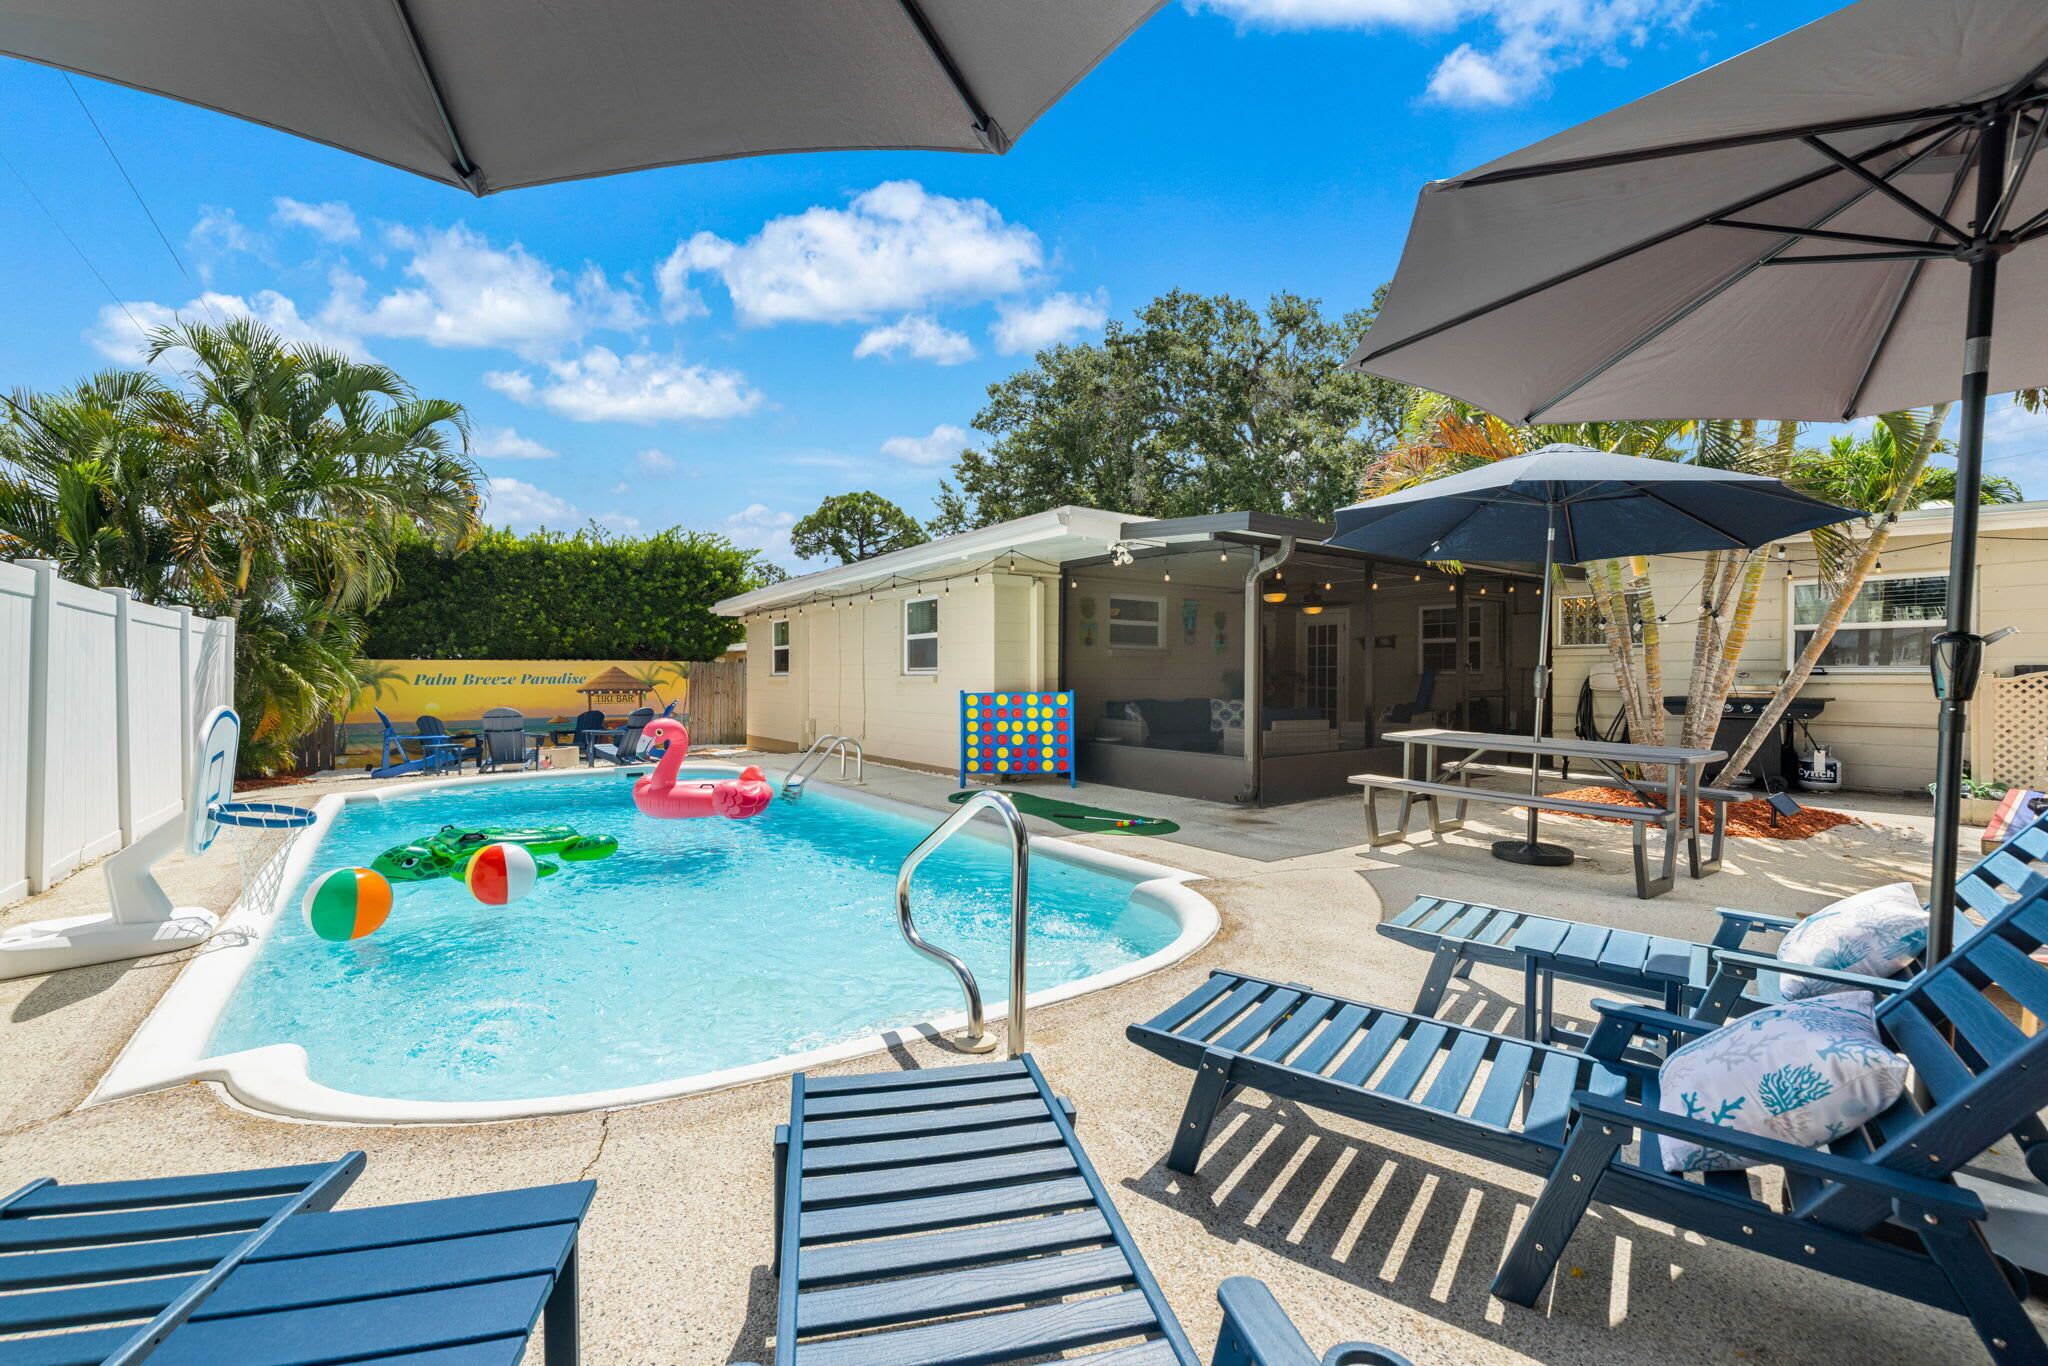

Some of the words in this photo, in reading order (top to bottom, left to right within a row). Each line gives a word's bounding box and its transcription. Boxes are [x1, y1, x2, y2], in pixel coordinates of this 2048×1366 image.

[414, 673, 457, 686] Palm
[462, 674, 516, 686] Breeze
[520, 672, 587, 685] Paradise
[596, 695, 613, 703] TIKI
[616, 695, 634, 703] BAR
